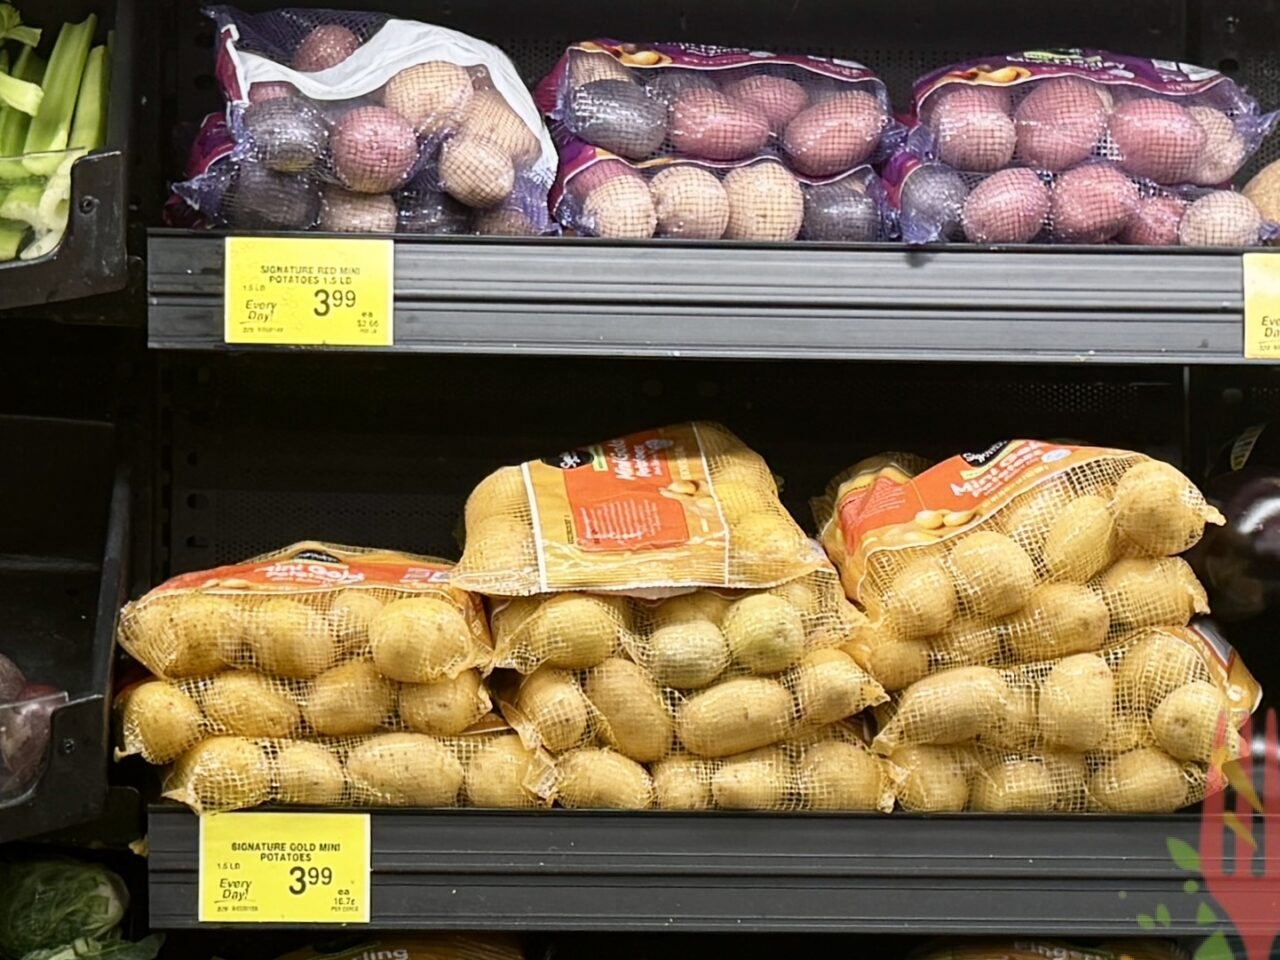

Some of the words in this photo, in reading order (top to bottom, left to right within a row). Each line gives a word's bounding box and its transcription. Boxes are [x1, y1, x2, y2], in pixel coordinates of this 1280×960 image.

[260, 265, 314, 275] SIGNATURE
[317, 266, 336, 276] RED
[269, 275, 319, 285] POTATOES
[245, 299, 277, 314] Every
[248, 310, 274, 323] Day!
[231, 842, 287, 852] SIGNATURE
[290, 842, 316, 852] GOLD
[319, 842, 341, 852] MINI
[260, 853, 312, 862] POTATOES
[219, 878, 252, 890] Every
[222, 888, 249, 901] Day!
